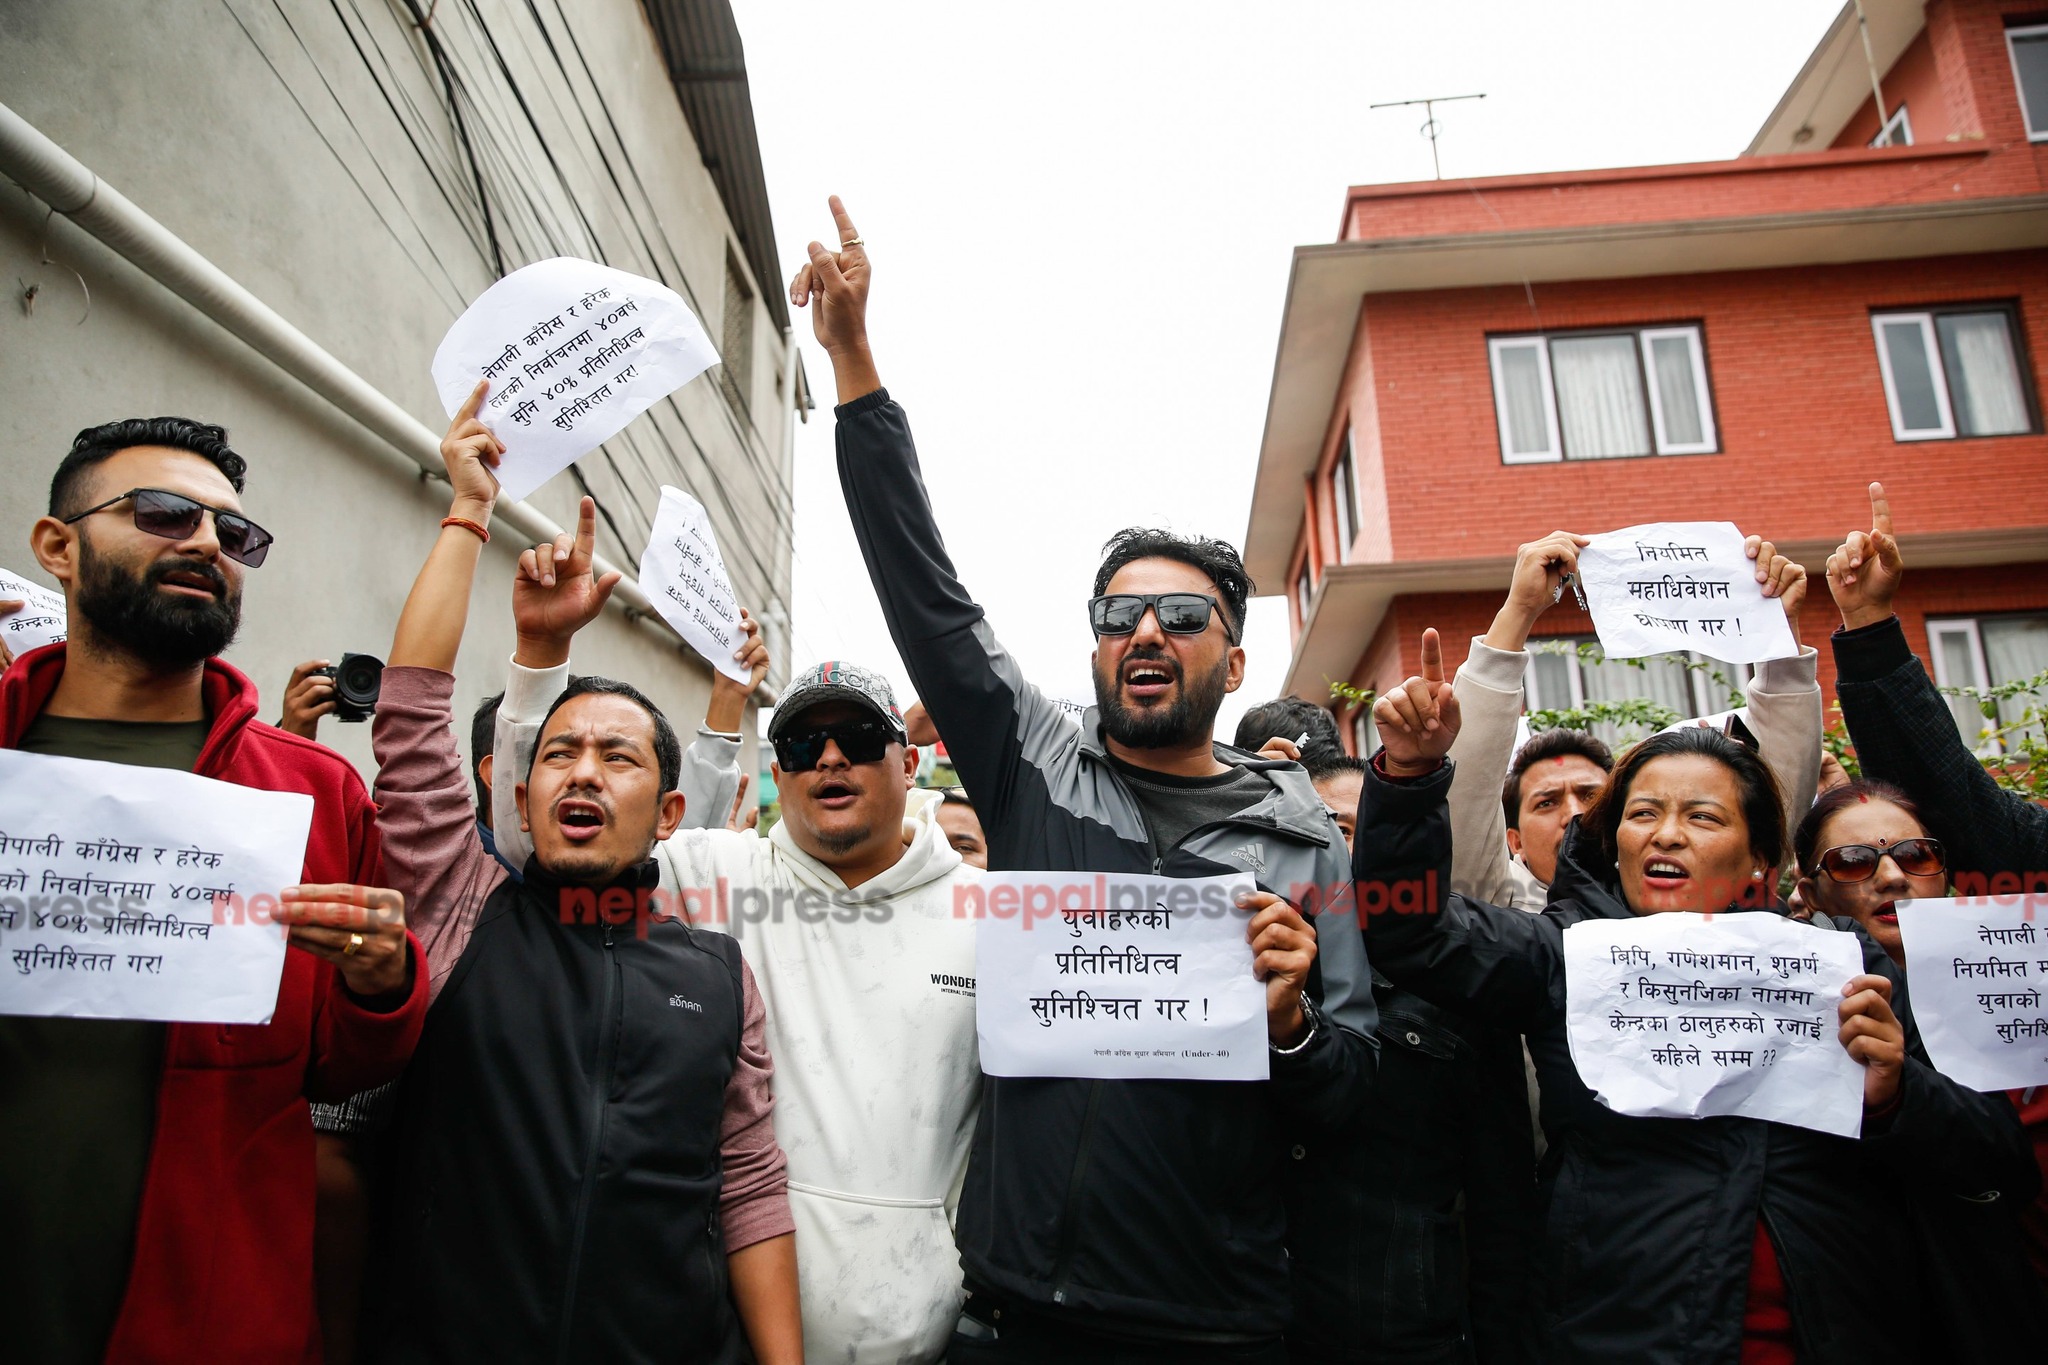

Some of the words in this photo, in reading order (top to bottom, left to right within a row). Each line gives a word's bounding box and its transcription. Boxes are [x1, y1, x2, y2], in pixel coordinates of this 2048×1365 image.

[481, 344, 521, 380] नेपाली
[523, 314, 565, 347] काँग्रेस
[566, 306, 580, 318] र
[580, 287, 611, 311] हरेक
[489, 376, 525, 408] तहको
[523, 329, 594, 380] निर्वाचनमा
[594, 297, 638, 331] ४०वर्ष
[511, 399, 540, 427] मुनि
[541, 375, 578, 401] ४०%
[578, 326, 645, 378] प्रतिनिधित्व
[613, 364, 639, 385] गर!
[1635, 541, 1709, 562] नियमित
[1627, 574, 1730, 601] महाधिवेशन
[1698, 619, 1727, 637] गर
[76, 837, 142, 865] काँग्रेस
[154, 846, 166, 866] र
[177, 844, 224, 870] हरेक
[1231, 850, 1267, 874] adidas
[41, 869, 156, 900] निर्वाचनमा
[169, 882, 235, 908] ४०वर्ष
[34, 911, 89, 934] ४०%
[103, 911, 214, 941] प्रतिनिधित्व
[1062, 903, 1173, 938] युवाहरुको
[1978, 923, 2035, 946] नेपाली
[127, 955, 163, 976] गर!
[1055, 945, 1182, 975] प्रतिनिधित्व
[1610, 945, 1656, 970] बिपि,
[1667, 948, 1761, 976] गणेशमान,
[1770, 952, 1819, 979] शुवर्ण
[1953, 956, 2027, 979] नियमित
[1620, 982, 1630, 998] र
[1638, 977, 1741, 1005] किसुनजिका
[1752, 986, 1814, 1006] नाममा
[1977, 988, 2042, 1014] युवाको
[1030, 990, 1142, 1028] सुनिश्चित
[1155, 998, 1190, 1021] गर
[1609, 1010, 1668, 1032] केन्द्रका
[1678, 1012, 1765, 1039] ठालुहरुको
[1774, 1017, 1823, 1040] रजाई
[1216, 1049, 1230, 1058] 40)
[1651, 1043, 1701, 1066] कहिले
[1711, 1050, 1753, 1067] सम्म
[1762, 1049, 1776, 1067] ??
